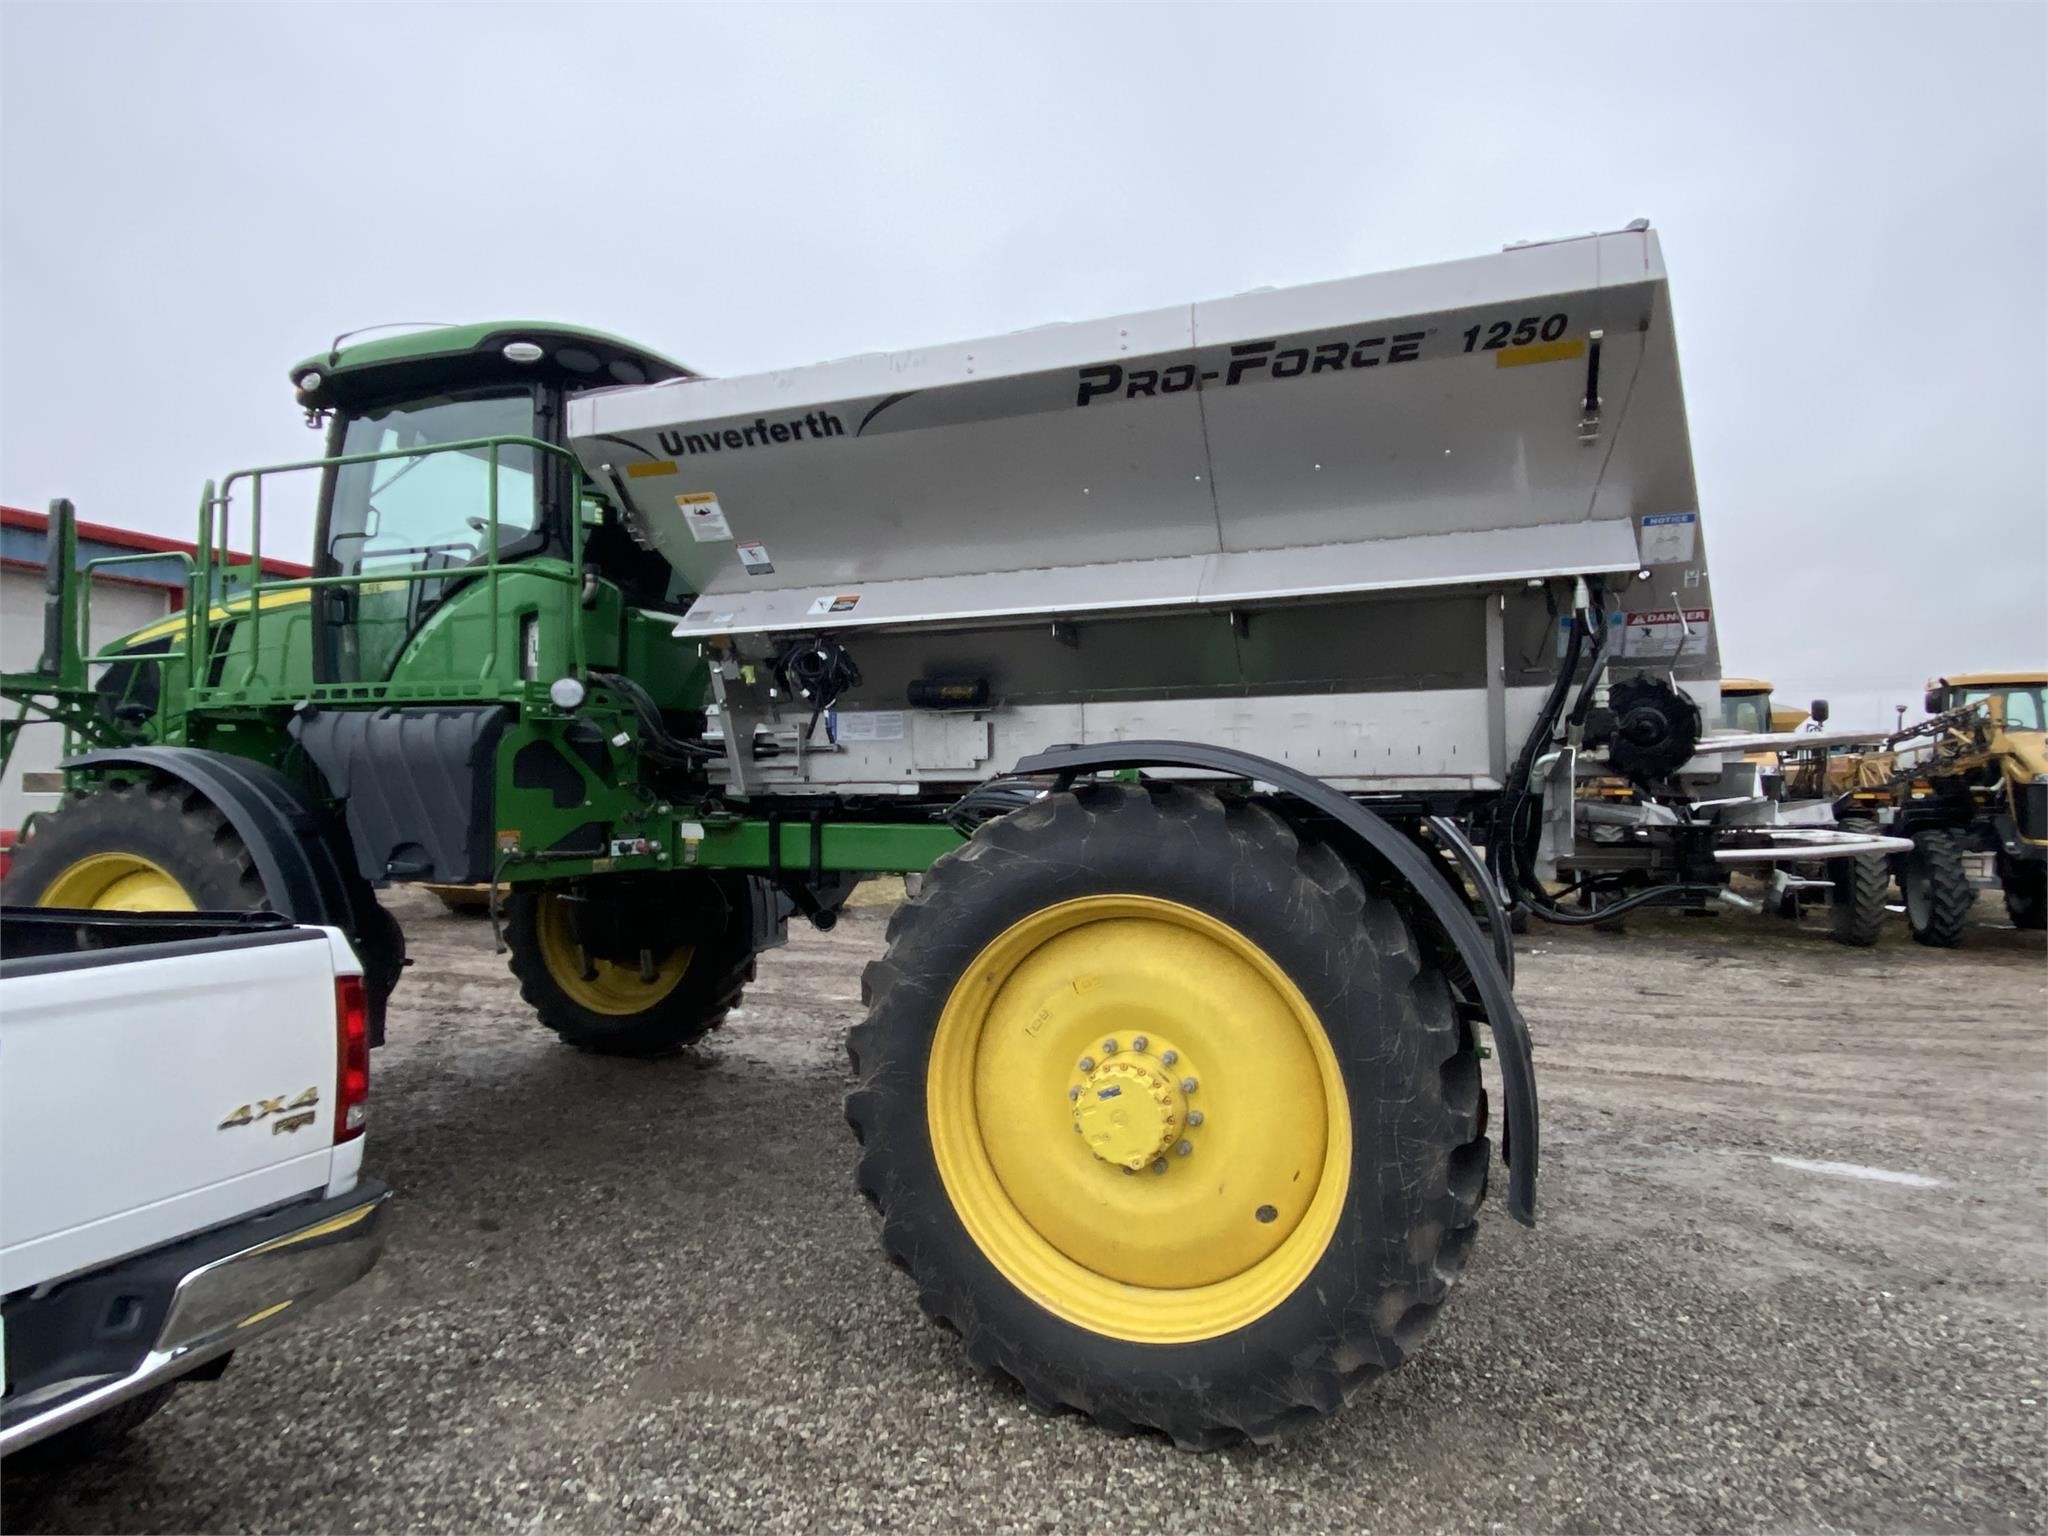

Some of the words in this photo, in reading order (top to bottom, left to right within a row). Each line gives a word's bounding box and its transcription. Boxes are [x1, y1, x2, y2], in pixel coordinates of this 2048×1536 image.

[1076, 331, 1426, 406] PRO-FORCE
[1462, 313, 1569, 353] 1250
[658, 411, 844, 456] Unverferth
[1650, 515, 1688, 525] NOTICE
